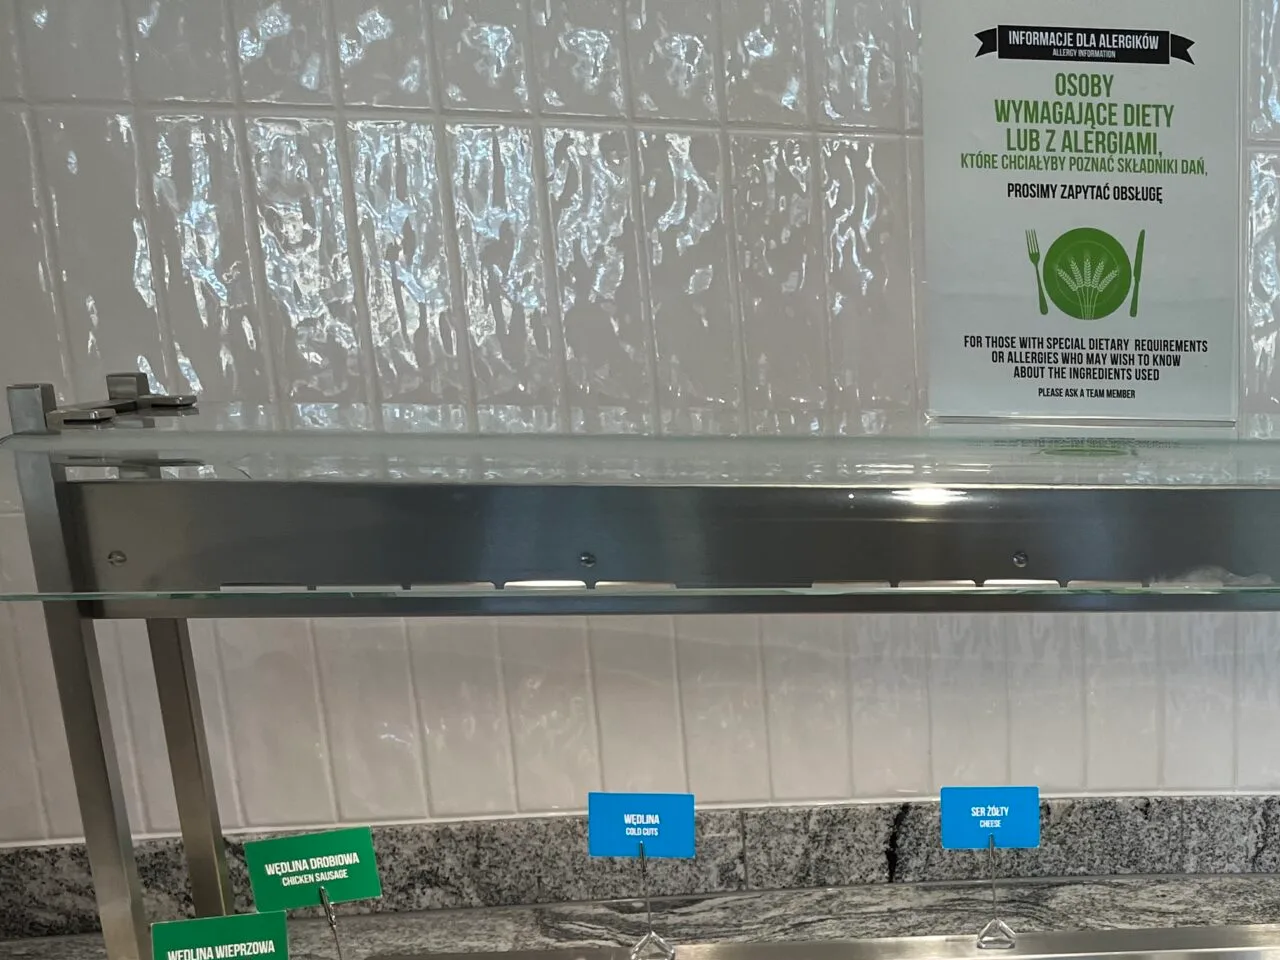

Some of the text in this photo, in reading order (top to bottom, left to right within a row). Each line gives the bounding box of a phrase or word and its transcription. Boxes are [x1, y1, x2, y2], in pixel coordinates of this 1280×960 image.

[1008, 30, 1159, 50] INFORMACJE DLA ALERGIKÓW
[1052, 48, 1116, 59] ALLERGY INFORMATION
[1055, 72, 1114, 98] OSOBY
[994, 99, 1175, 129] WYMAGAJĄCE DIETY
[1006, 128, 1163, 158] LUB Z ALERGIAMI,
[960, 153, 1209, 176] KTÓRE CHCIAŁYBY POZNAĆ SKŁADNIKI DAŃ,
[1007, 182, 1163, 204] PROSIMY ZAPYTAĆ OBSŁUGĘ
[964, 335, 1208, 353] FOR THOSE WITH SPECIAL DIETARY REQUIREMENTS
[991, 351, 1181, 367] OR ALLERGIES WHO MAY WISH TO KNOW
[1013, 366, 1160, 381] ABOUT THE INGREDIENTS USED
[1038, 388, 1136, 399] PLEASE ASK A TEAM MEMBER
[624, 814, 660, 825] WĘDLINA
[971, 804, 1010, 817] SER ŻÓŁTY
[625, 827, 658, 836] COLD CUTS
[979, 819, 1002, 828] CHEESE
[265, 852, 360, 876] WĘDLINA DROBIOWA
[281, 869, 349, 887] CHICKEN SAUSAGE
[215, 940, 275, 959] WIEPRZOWA
